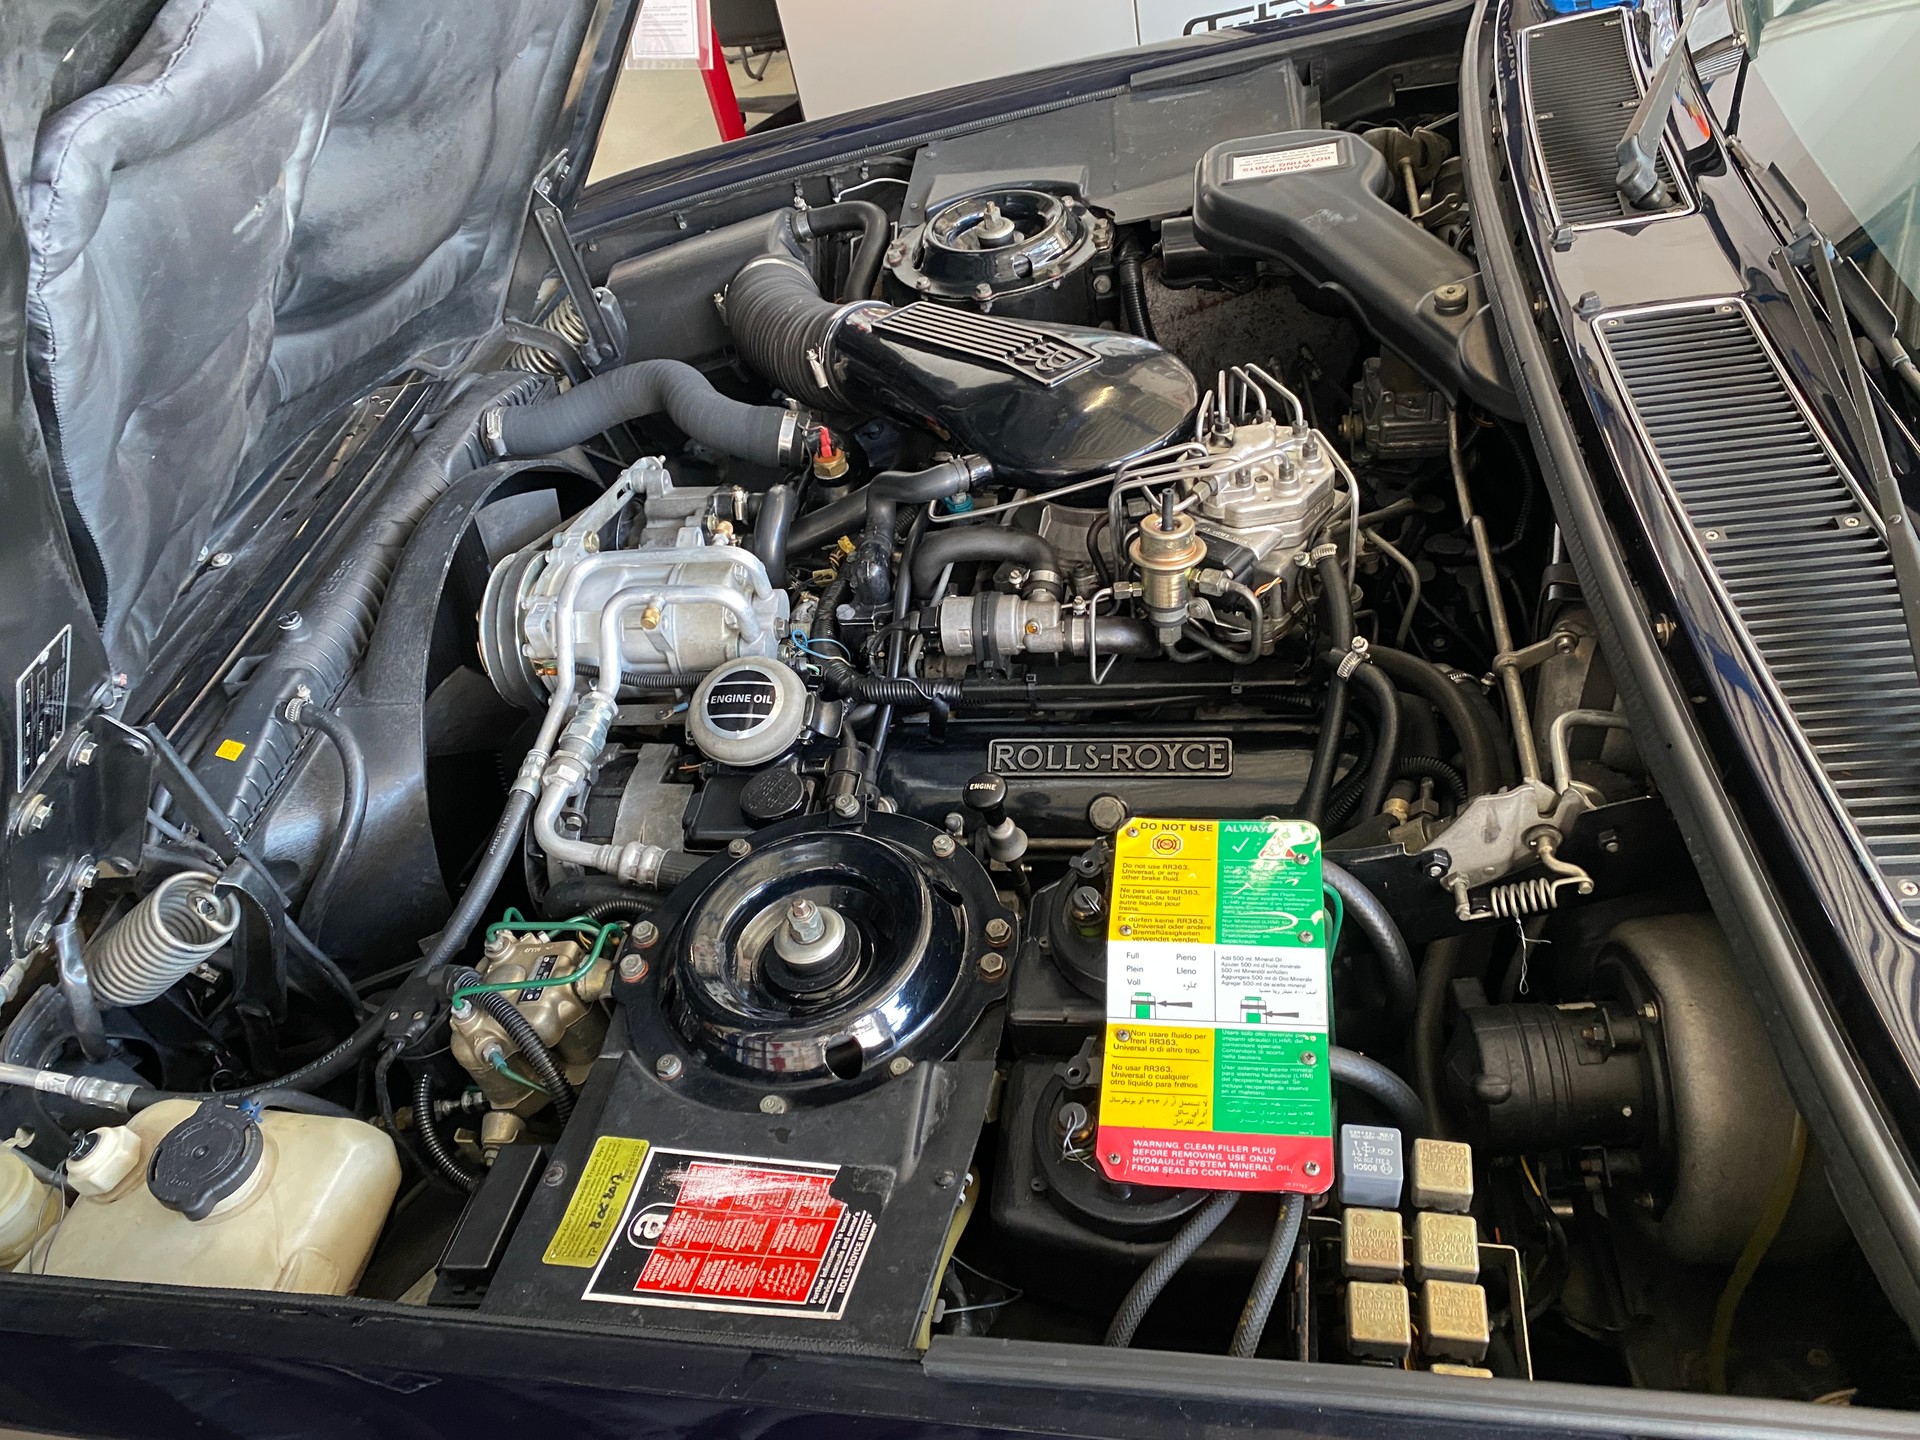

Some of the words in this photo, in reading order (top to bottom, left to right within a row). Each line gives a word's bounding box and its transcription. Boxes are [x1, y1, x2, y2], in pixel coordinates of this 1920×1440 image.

[710, 695, 751, 704] ENGINE
[754, 695, 772, 704] OIL
[994, 743, 1225, 771] ROLLS-ROYCE
[970, 783, 996, 791] ENGINE
[1113, 1043, 1147, 1051] Universal
[1133, 1140, 1179, 1149] WARNING.
[1184, 1142, 1214, 1151] CLEAN
[1218, 1145, 1249, 1153] FILLER
[1252, 1146, 1276, 1155] PLUG
[1133, 1148, 1169, 1158] BEFORE
[1172, 1150, 1224, 1160] REMOVING.
[1228, 1153, 1246, 1162] USE
[1250, 1155, 1275, 1163] ONLY
[1132, 1157, 1185, 1167] HYDRAULIC
[1188, 1159, 1227, 1169] SYSTEM
[1230, 1162, 1273, 1171] MINERAL
[1132, 1164, 1160, 1173] FROM
[1162, 1166, 1198, 1176] SEALED
[1201, 1169, 1258, 1179] CONTAINER.
[1354, 1163, 1377, 1172] BOSCH
[808, 1277, 825, 1303] Further
[819, 1240, 841, 1277] information
[817, 1279, 834, 1304] Service
[828, 1250, 845, 1278] manuals
[839, 1237, 850, 1249] and
[836, 1241, 864, 1293] ROLLS-ROYCE
